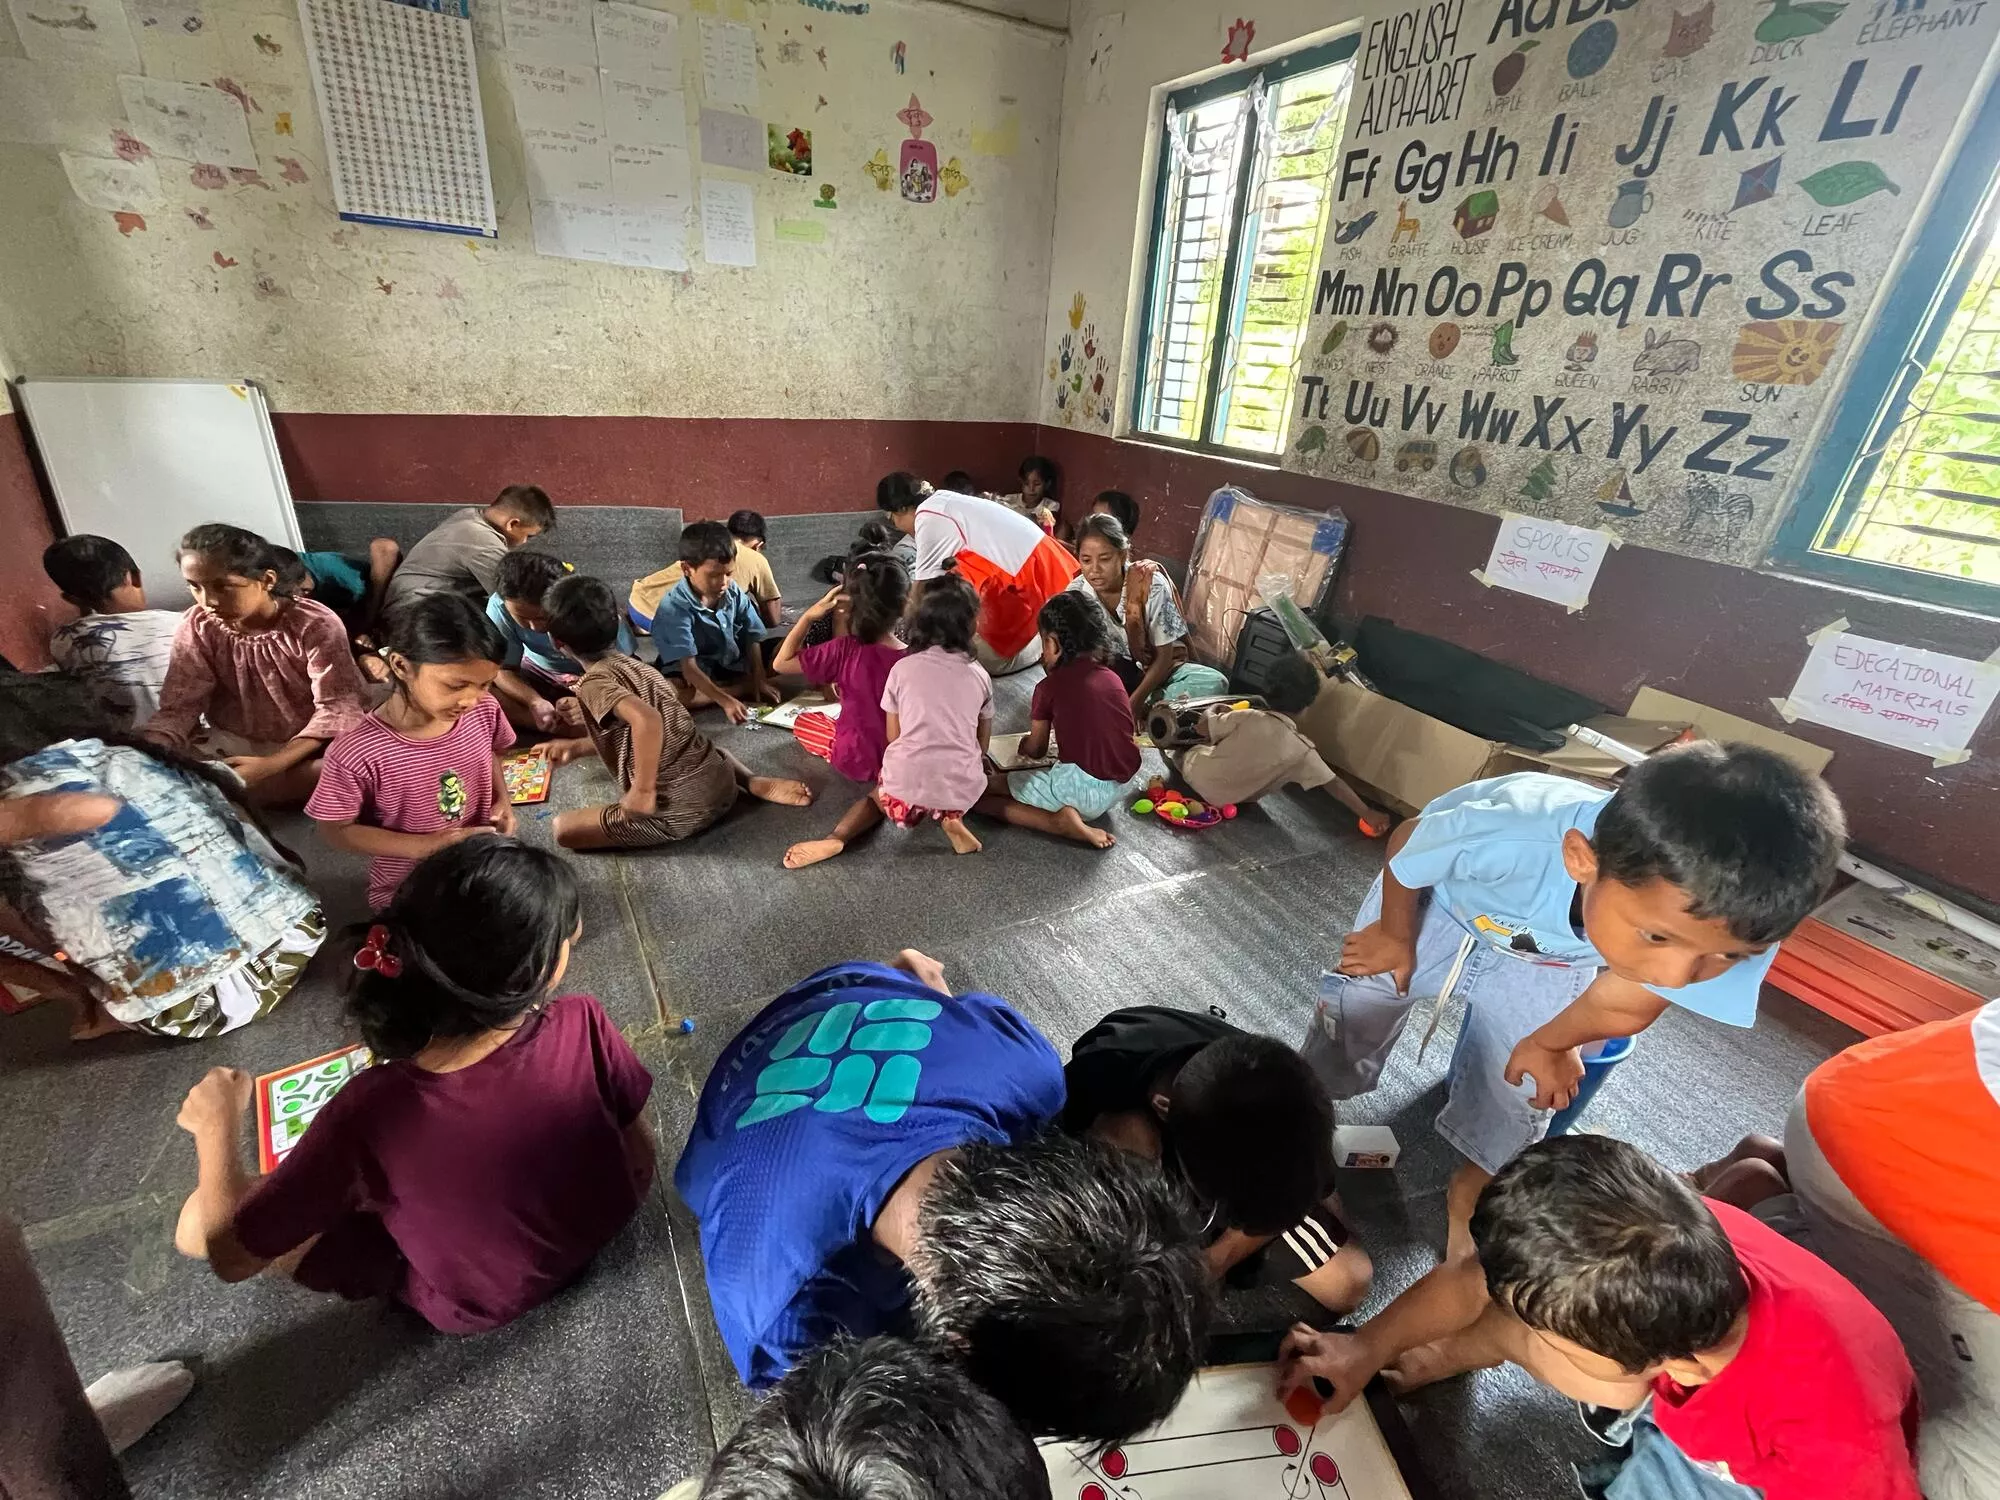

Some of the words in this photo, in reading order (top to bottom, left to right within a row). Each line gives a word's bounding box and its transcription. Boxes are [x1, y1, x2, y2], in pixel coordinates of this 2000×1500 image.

[1856, 2, 1988, 46] ELEPHANT
[1362, 0, 1464, 81] ENGLISH
[1750, 39, 1805, 65] DUCK
[1355, 53, 1477, 139] ALPHABET
[1559, 82, 1601, 102] BALL
[1337, 148, 1381, 201] Ff
[1394, 139, 1452, 203] Gg
[1455, 126, 1520, 187] Hh
[1538, 113, 1580, 177] Ii
[1615, 95, 1678, 178] Jj
[1698, 75, 1801, 156] Kk
[1817, 58, 1923, 142] Ll
[1601, 228, 1640, 246] JUG
[1695, 219, 1737, 241] KITE
[1802, 212, 1866, 237] LEAF
[1450, 238, 1489, 255] HOUSE
[1314, 269, 1364, 315] Mm
[1368, 267, 1418, 316] Nn
[1424, 265, 1482, 317] Oo
[1487, 262, 1551, 328] Pp
[1563, 257, 1640, 329] Qq
[1645, 253, 1732, 317] Rr
[1746, 249, 1855, 320] Ss
[1476, 367, 1522, 384] PARROT
[1554, 372, 1600, 389] QUEEN
[1628, 375, 1687, 395] RABBIT
[1739, 383, 1784, 402] SUN
[1302, 375, 1329, 420] Tt
[1344, 380, 1390, 428] Uu
[1401, 384, 1447, 435] Vv
[1458, 389, 1520, 444] Ww
[1518, 395, 1595, 454] Xx
[1606, 402, 1678, 474] Yy
[1683, 410, 1790, 481] Zz
[1513, 526, 1592, 562] SPORTS
[1834, 645, 1975, 699] EDECATIONAL
[1852, 680, 1969, 717] MATERIALS
